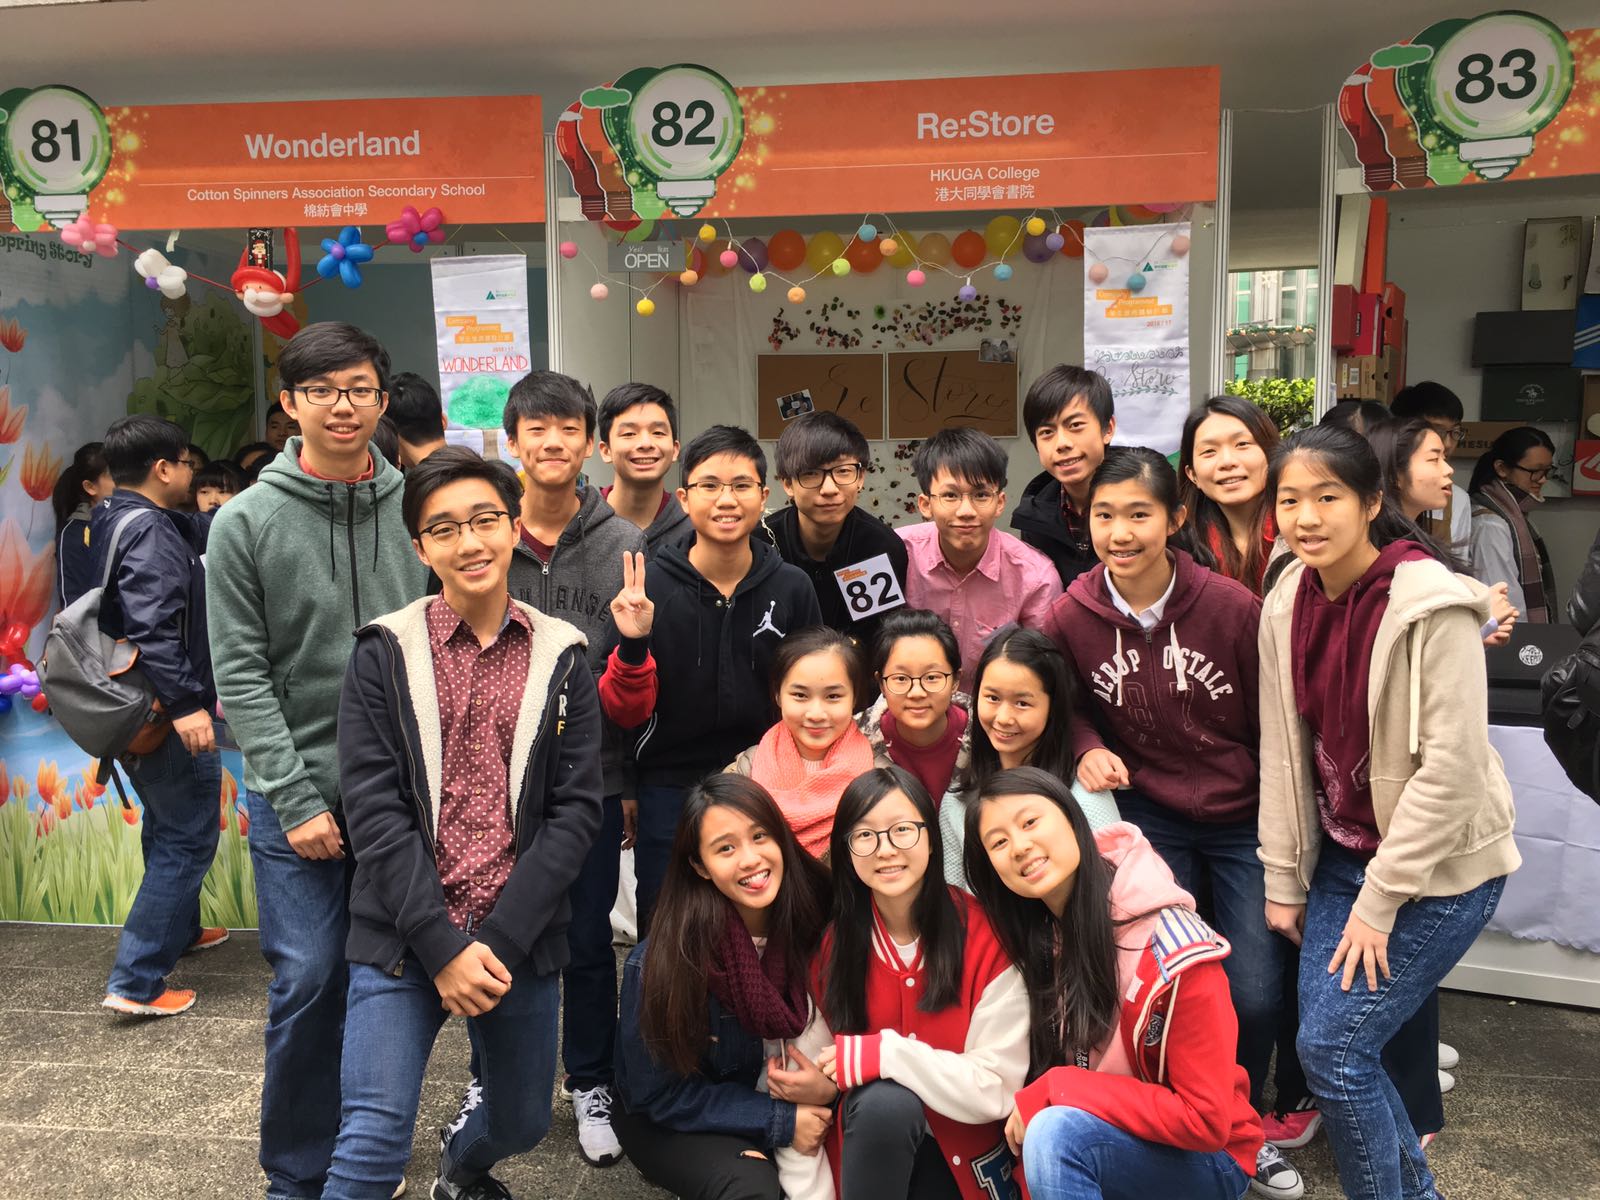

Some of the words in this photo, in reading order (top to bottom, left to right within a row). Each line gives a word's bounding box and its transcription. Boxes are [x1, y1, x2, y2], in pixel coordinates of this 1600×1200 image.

[1454, 48, 1538, 104] 83
[651, 100, 716, 147] 82
[917, 110, 1055, 140] Re:Store
[31, 119, 82, 163] 81
[245, 130, 421, 160] Wonderland
[930, 168, 983, 181] HKUGA
[987, 167, 1040, 182] College
[187, 188, 229, 201] Cotton
[233, 188, 288, 203] Spinners
[292, 186, 364, 200] Association
[368, 184, 438, 200] Secondary
[441, 184, 486, 196] School
[935, 184, 1035, 202] 港大同學會書院
[49, 240, 93, 269] Story
[624, 253, 669, 269] OPEN
[443, 354, 529, 373] WONDERLAND
[846, 572, 900, 613] 82
